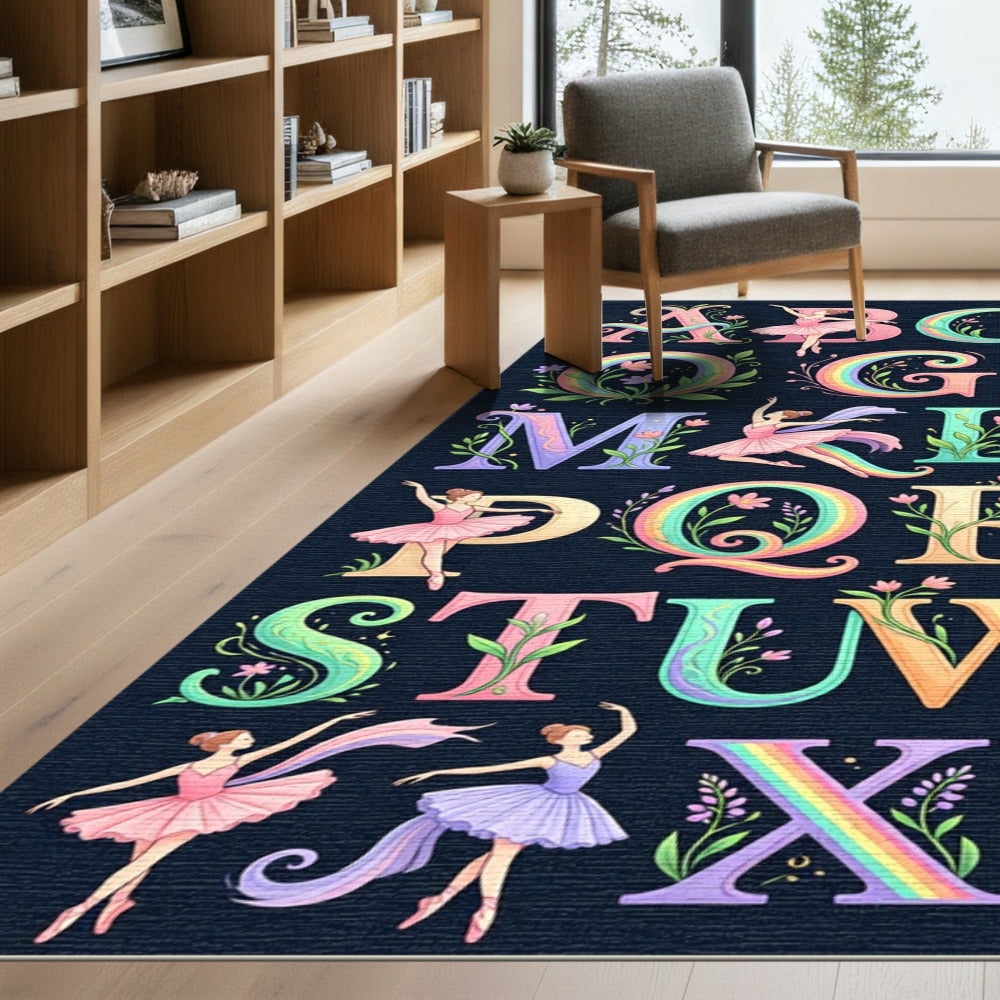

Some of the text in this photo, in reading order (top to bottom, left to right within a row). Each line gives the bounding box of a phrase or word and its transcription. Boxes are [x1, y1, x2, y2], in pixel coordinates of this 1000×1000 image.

[763, 307, 901, 343] B
[816, 350, 997, 398] G
[434, 411, 704, 470] M
[344, 495, 601, 577] P
[634, 480, 868, 579] Q
[180, 595, 414, 708] S
[415, 591, 660, 700] T
[658, 598, 863, 708] U
